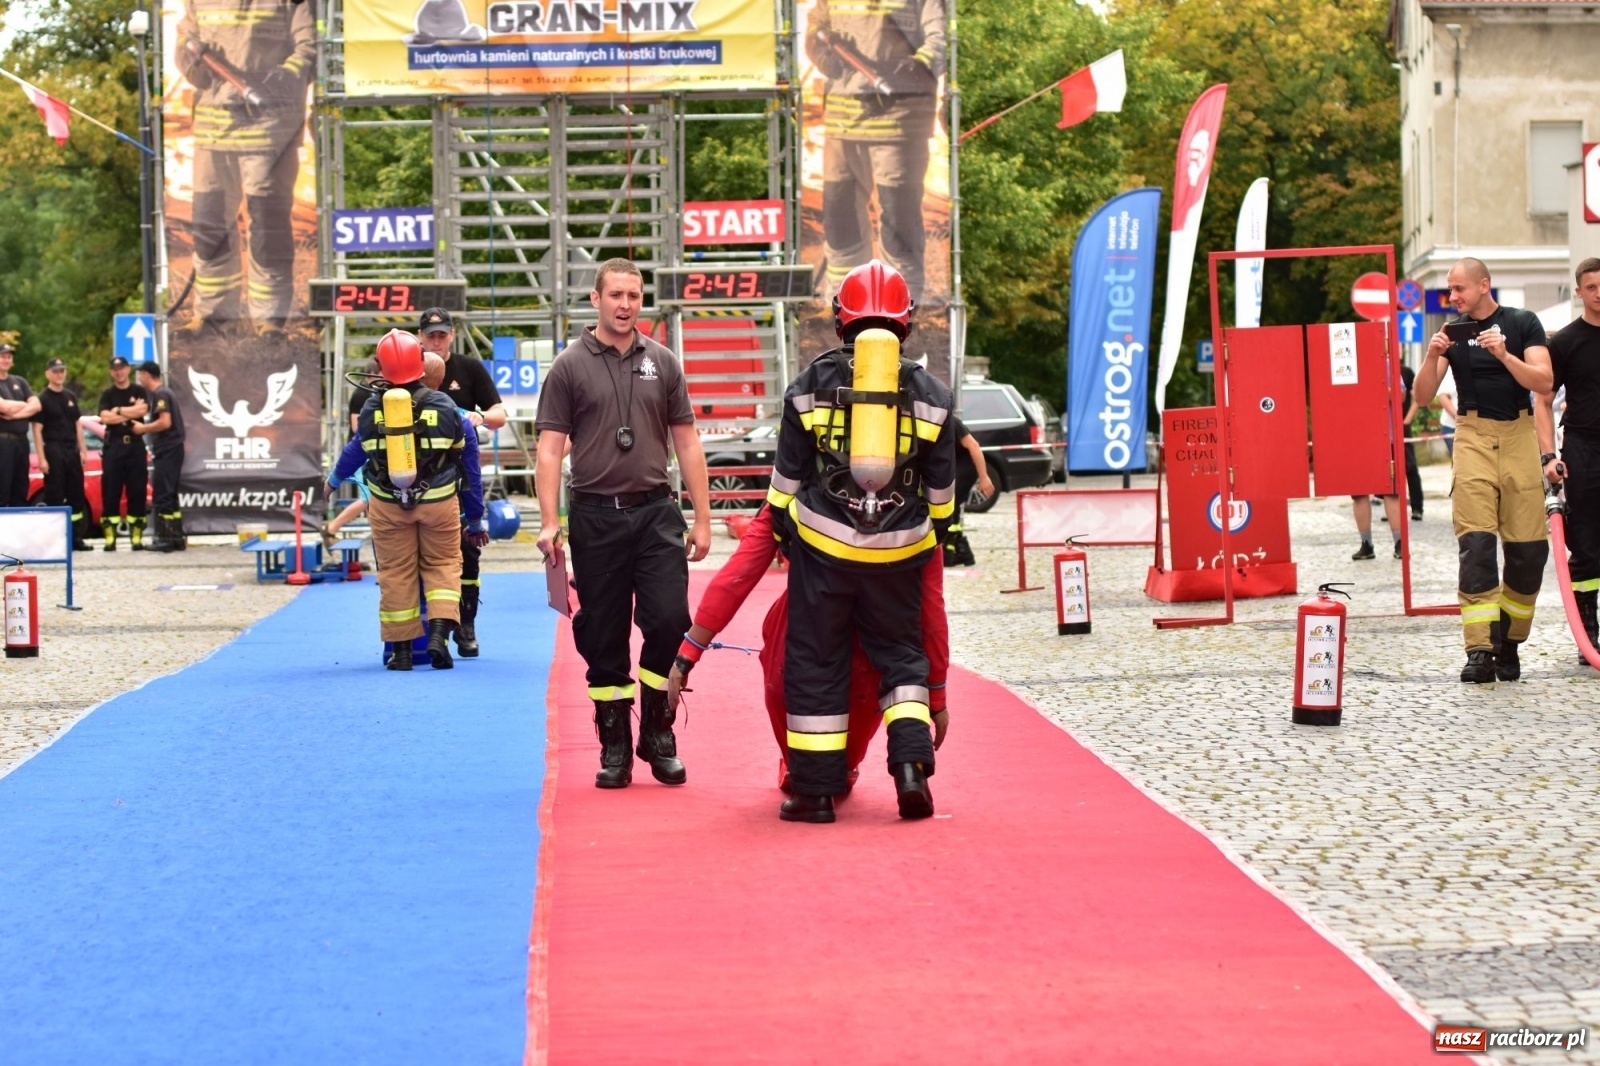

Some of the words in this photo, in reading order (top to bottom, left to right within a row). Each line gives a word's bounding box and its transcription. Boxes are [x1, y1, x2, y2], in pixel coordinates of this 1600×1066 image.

[489, 1, 698, 34] GRAN-MIX
[414, 51, 477, 64] hurtownia
[480, 49, 529, 62] kamieni
[533, 48, 607, 63] naturalnych
[610, 48, 614, 60] i
[617, 46, 655, 60] kostki
[659, 46, 717, 61] brukowej
[335, 214, 434, 244] START
[683, 207, 782, 237] START
[1201, 342, 1213, 360] P
[1099, 268, 1144, 469] ostrog.net
[215, 437, 271, 459] FHR
[177, 486, 315, 511] www.kzpt.pl
